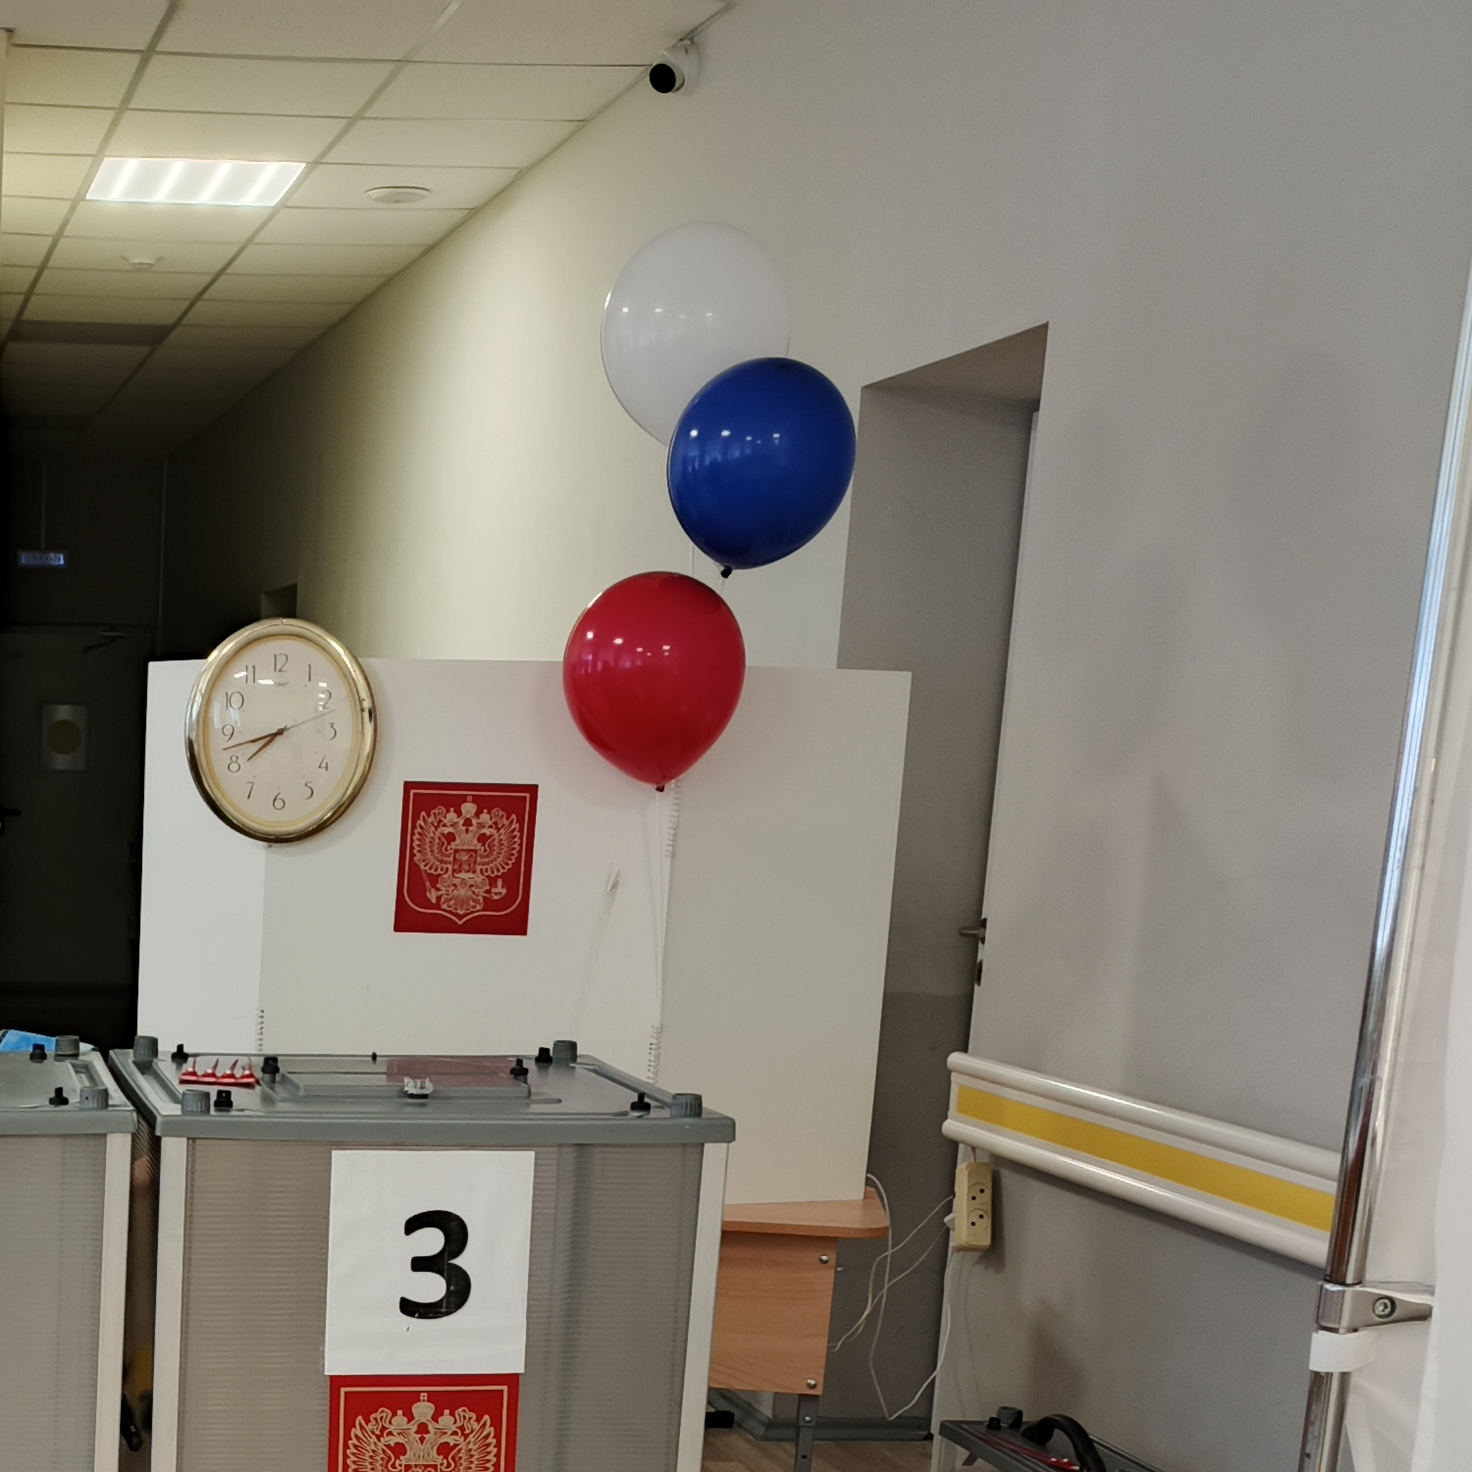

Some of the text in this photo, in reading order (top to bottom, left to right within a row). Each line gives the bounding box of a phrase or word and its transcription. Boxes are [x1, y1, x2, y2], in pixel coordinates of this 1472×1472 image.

[273, 653, 289, 673] 12
[307, 663, 312, 682] 1
[245, 665, 256, 684] 11
[225, 691, 245, 710] 10
[319, 689, 332, 710] 2
[221, 724, 235, 742] 9
[328, 722, 337, 741] 3
[227, 754, 241, 773] 8
[318, 755, 329, 773] 4
[246, 782, 255, 800] 7
[304, 781, 314, 800] 5
[272, 791, 286, 811] 6
[399, 1209, 472, 1320] 3
